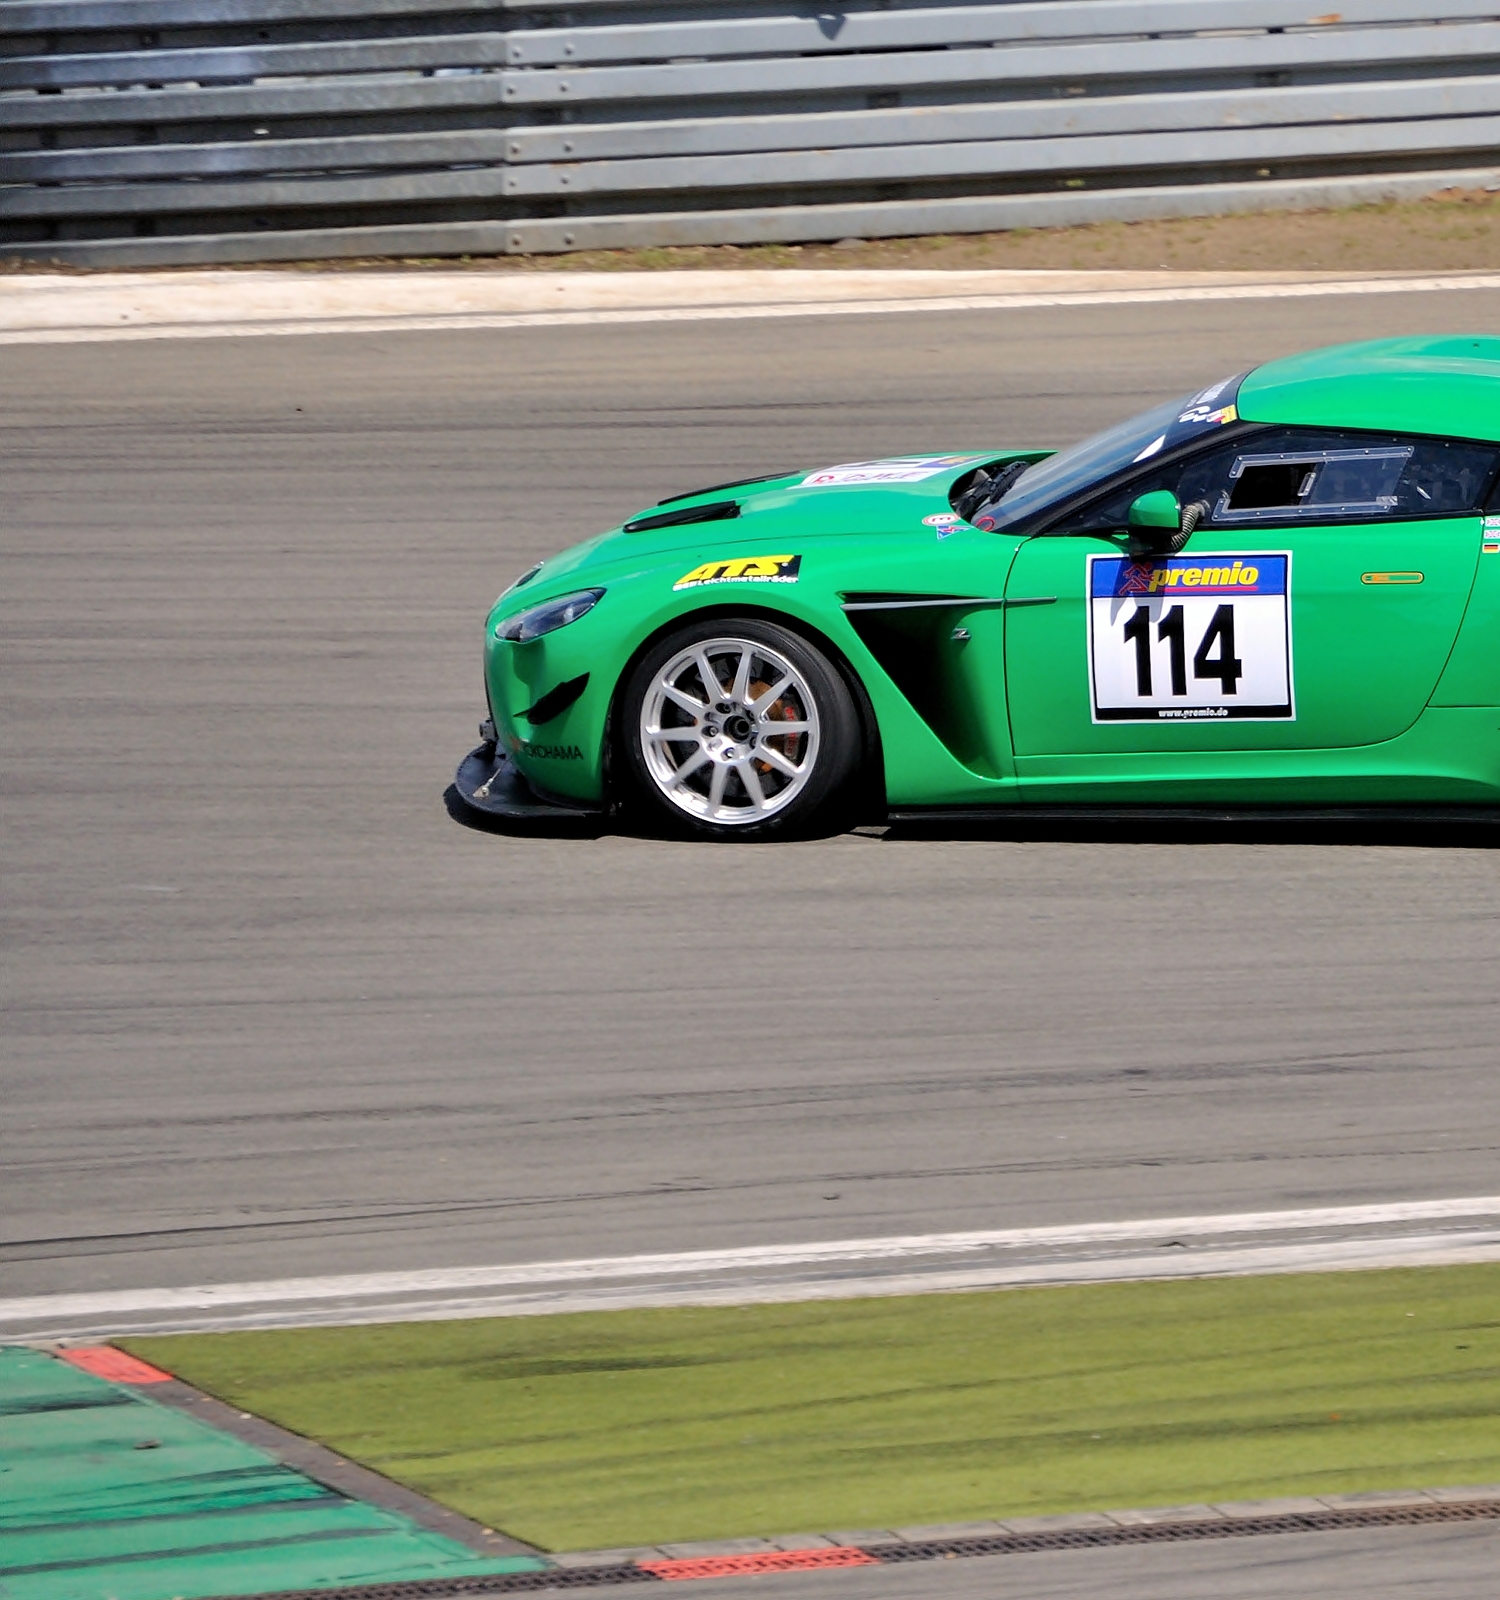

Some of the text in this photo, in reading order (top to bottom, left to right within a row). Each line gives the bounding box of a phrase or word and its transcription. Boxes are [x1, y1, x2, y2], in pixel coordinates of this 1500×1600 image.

[674, 554, 795, 585] ATS
[1148, 561, 1259, 592] premio
[1123, 604, 1243, 697] 114
[1158, 707, 1229, 719] www.premio.de
[519, 742, 584, 760] OKOHAMA
